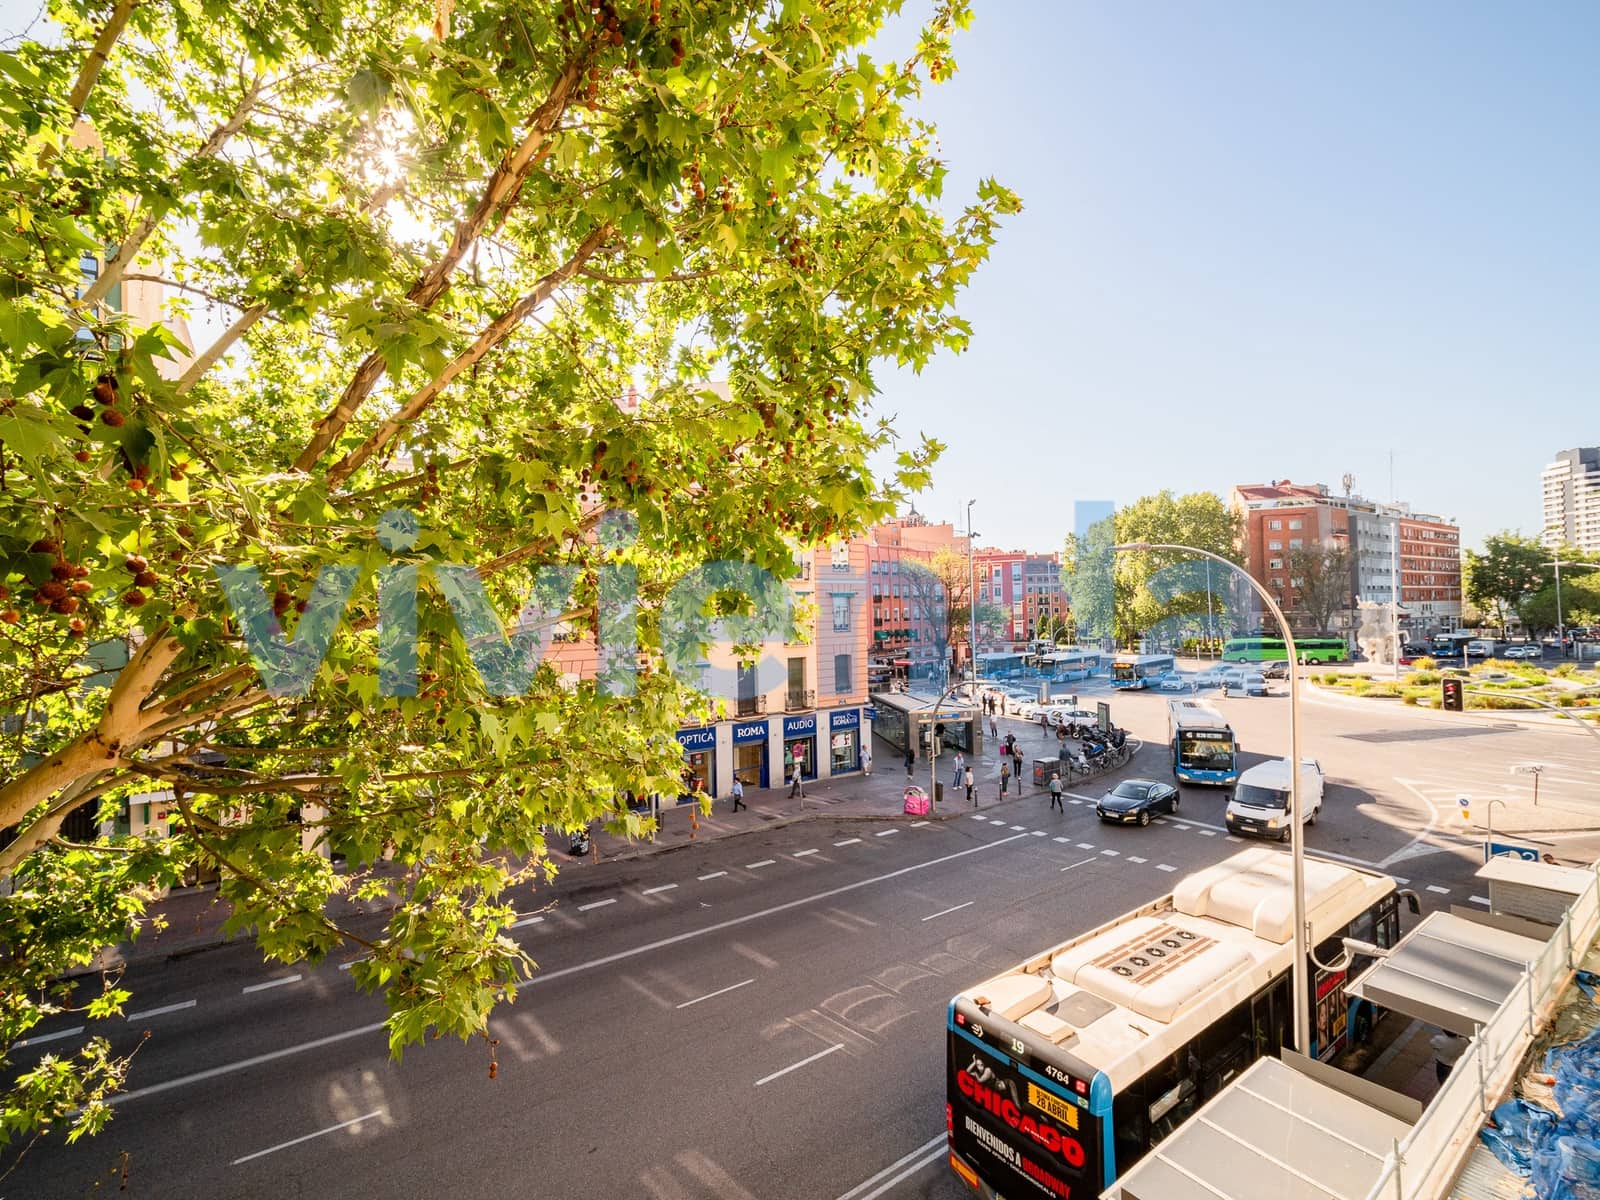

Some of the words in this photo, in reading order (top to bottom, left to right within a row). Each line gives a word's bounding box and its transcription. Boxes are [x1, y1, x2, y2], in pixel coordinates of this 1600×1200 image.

[737, 725, 765, 739] ROMA
[787, 719, 814, 731] AUDIO
[678, 732, 715, 746] OPTICA
[1011, 1038, 1025, 1054] 19
[1045, 1065, 1070, 1085] 4764
[1036, 1095, 1047, 1110] 28
[1047, 1101, 1069, 1122] ABRIL
[957, 1069, 1086, 1168] CHICAGO
[965, 1115, 1015, 1162] BIENVENIDOS
[1015, 1151, 1022, 1168] A
